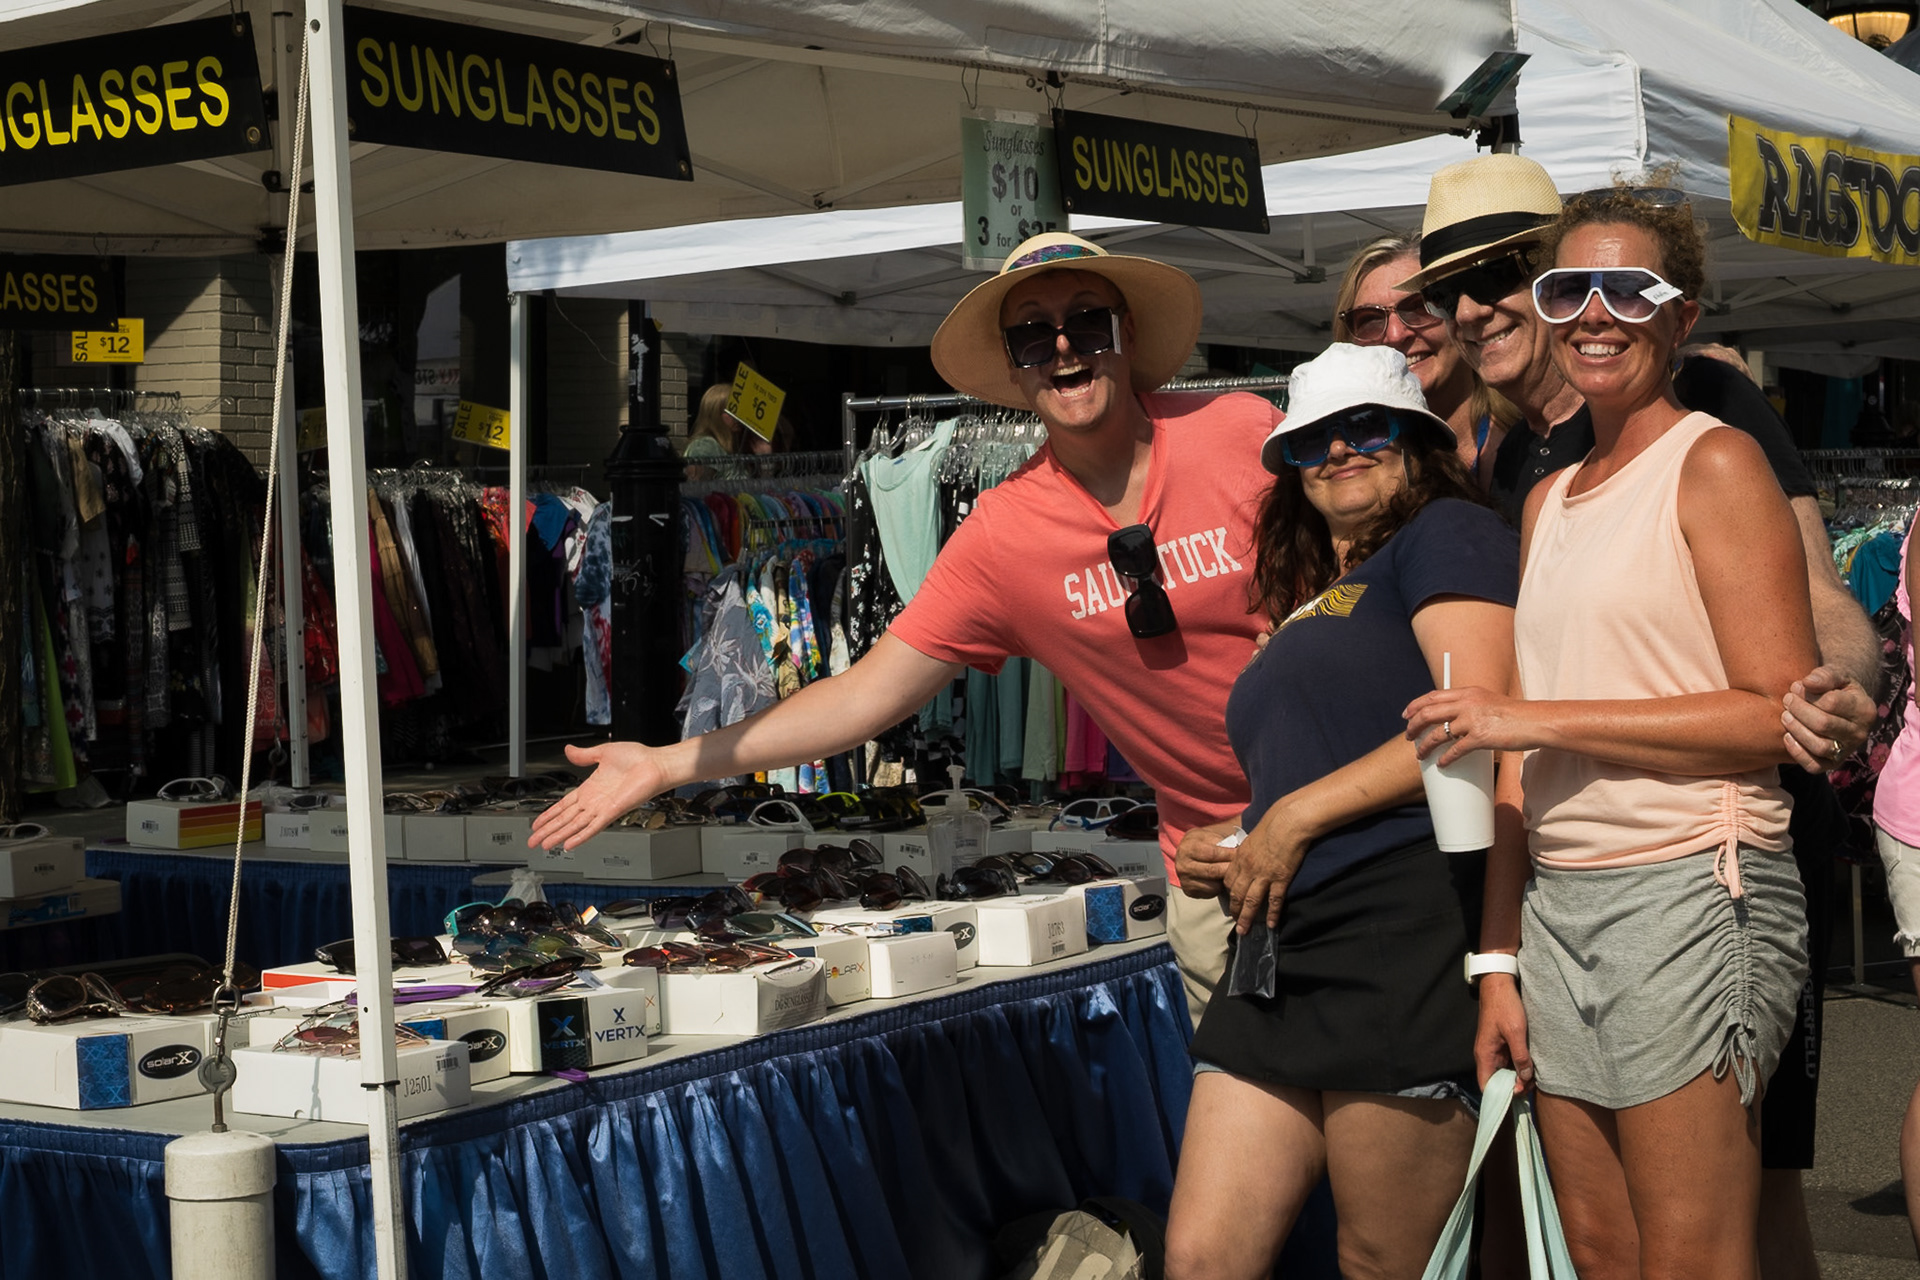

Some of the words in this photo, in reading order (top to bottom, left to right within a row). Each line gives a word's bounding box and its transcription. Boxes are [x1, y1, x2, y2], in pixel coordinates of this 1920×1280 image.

[356, 37, 661, 146] SUNGLASSES
[983, 129, 1046, 160] Sunglasses
[991, 161, 1039, 203] $10
[1072, 135, 1249, 208] SUNGLASSES
[1010, 204, 1023, 217] or
[977, 216, 990, 246] 3
[996, 232, 1012, 247] for
[0, 271, 98, 313] ASSES
[75, 331, 88, 362] SAL
[100, 336, 130, 354] $12
[728, 365, 750, 415] SALE
[454, 403, 473, 439] SALE
[752, 397, 768, 420] $6
[478, 421, 504, 441] $12
[1063, 526, 1243, 620] SAUTUCK
[466, 1035, 499, 1051] olarX
[543, 1038, 586, 1050] VERTX
[594, 1025, 646, 1043] VERTX
[404, 1075, 432, 1098] J2501
